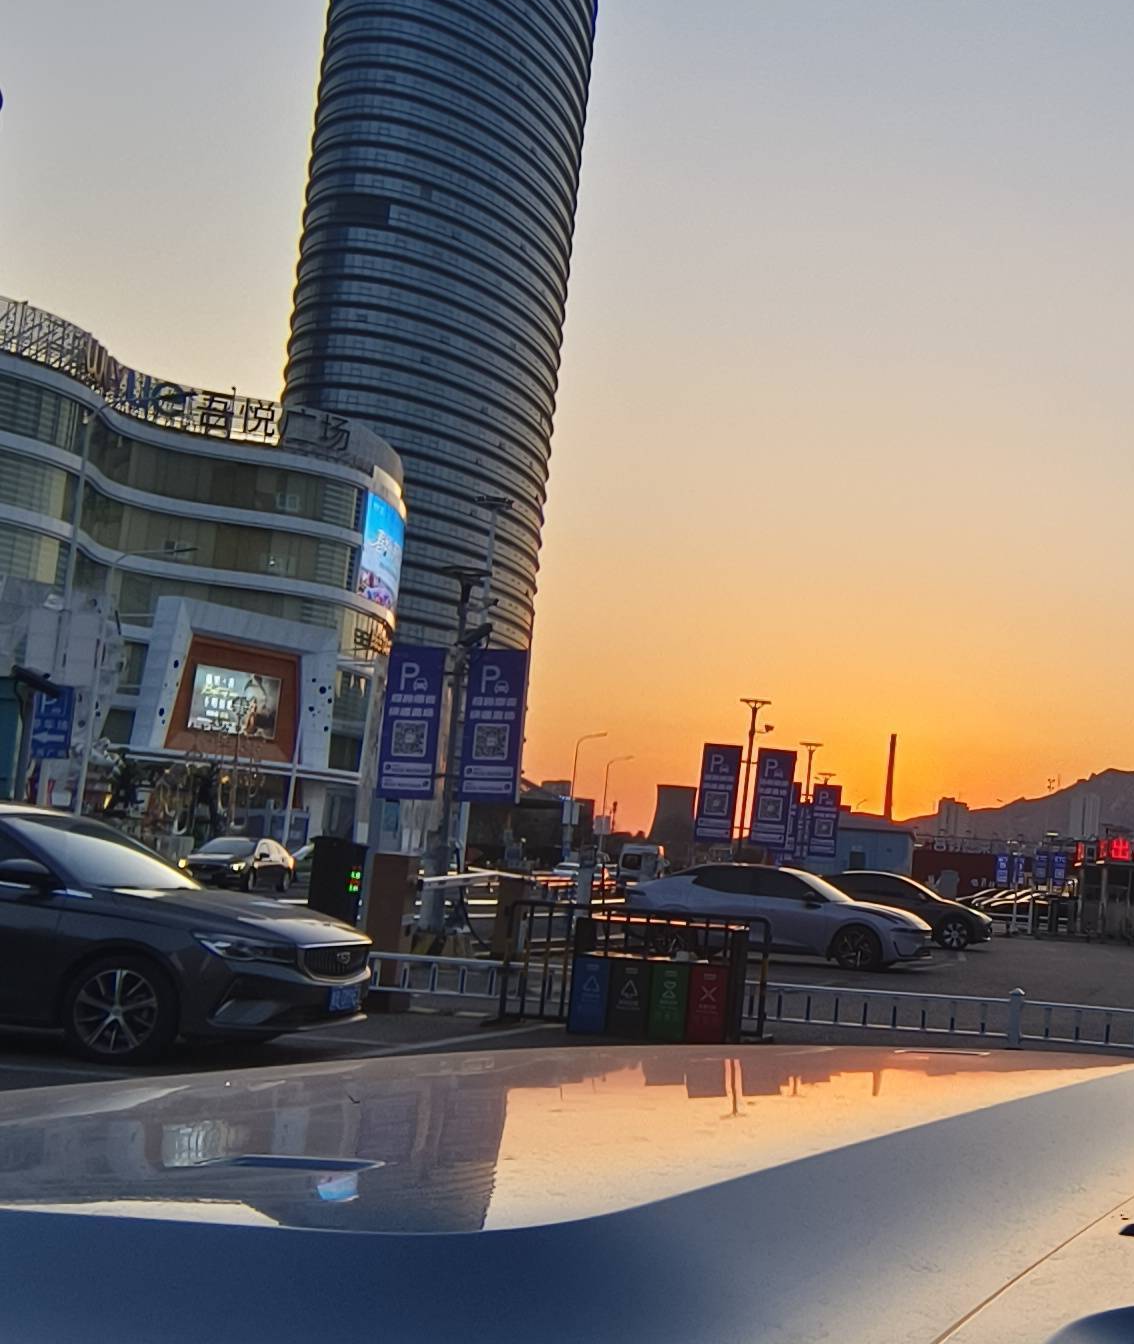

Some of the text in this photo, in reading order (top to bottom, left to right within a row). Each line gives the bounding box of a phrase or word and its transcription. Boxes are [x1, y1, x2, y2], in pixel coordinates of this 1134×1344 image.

[201, 390, 350, 452] 吾悦广场
[400, 661, 420, 691] P
[481, 665, 501, 694] P
[710, 754, 724, 773] P
[764, 758, 778, 778] P
[818, 791, 829, 805] P
